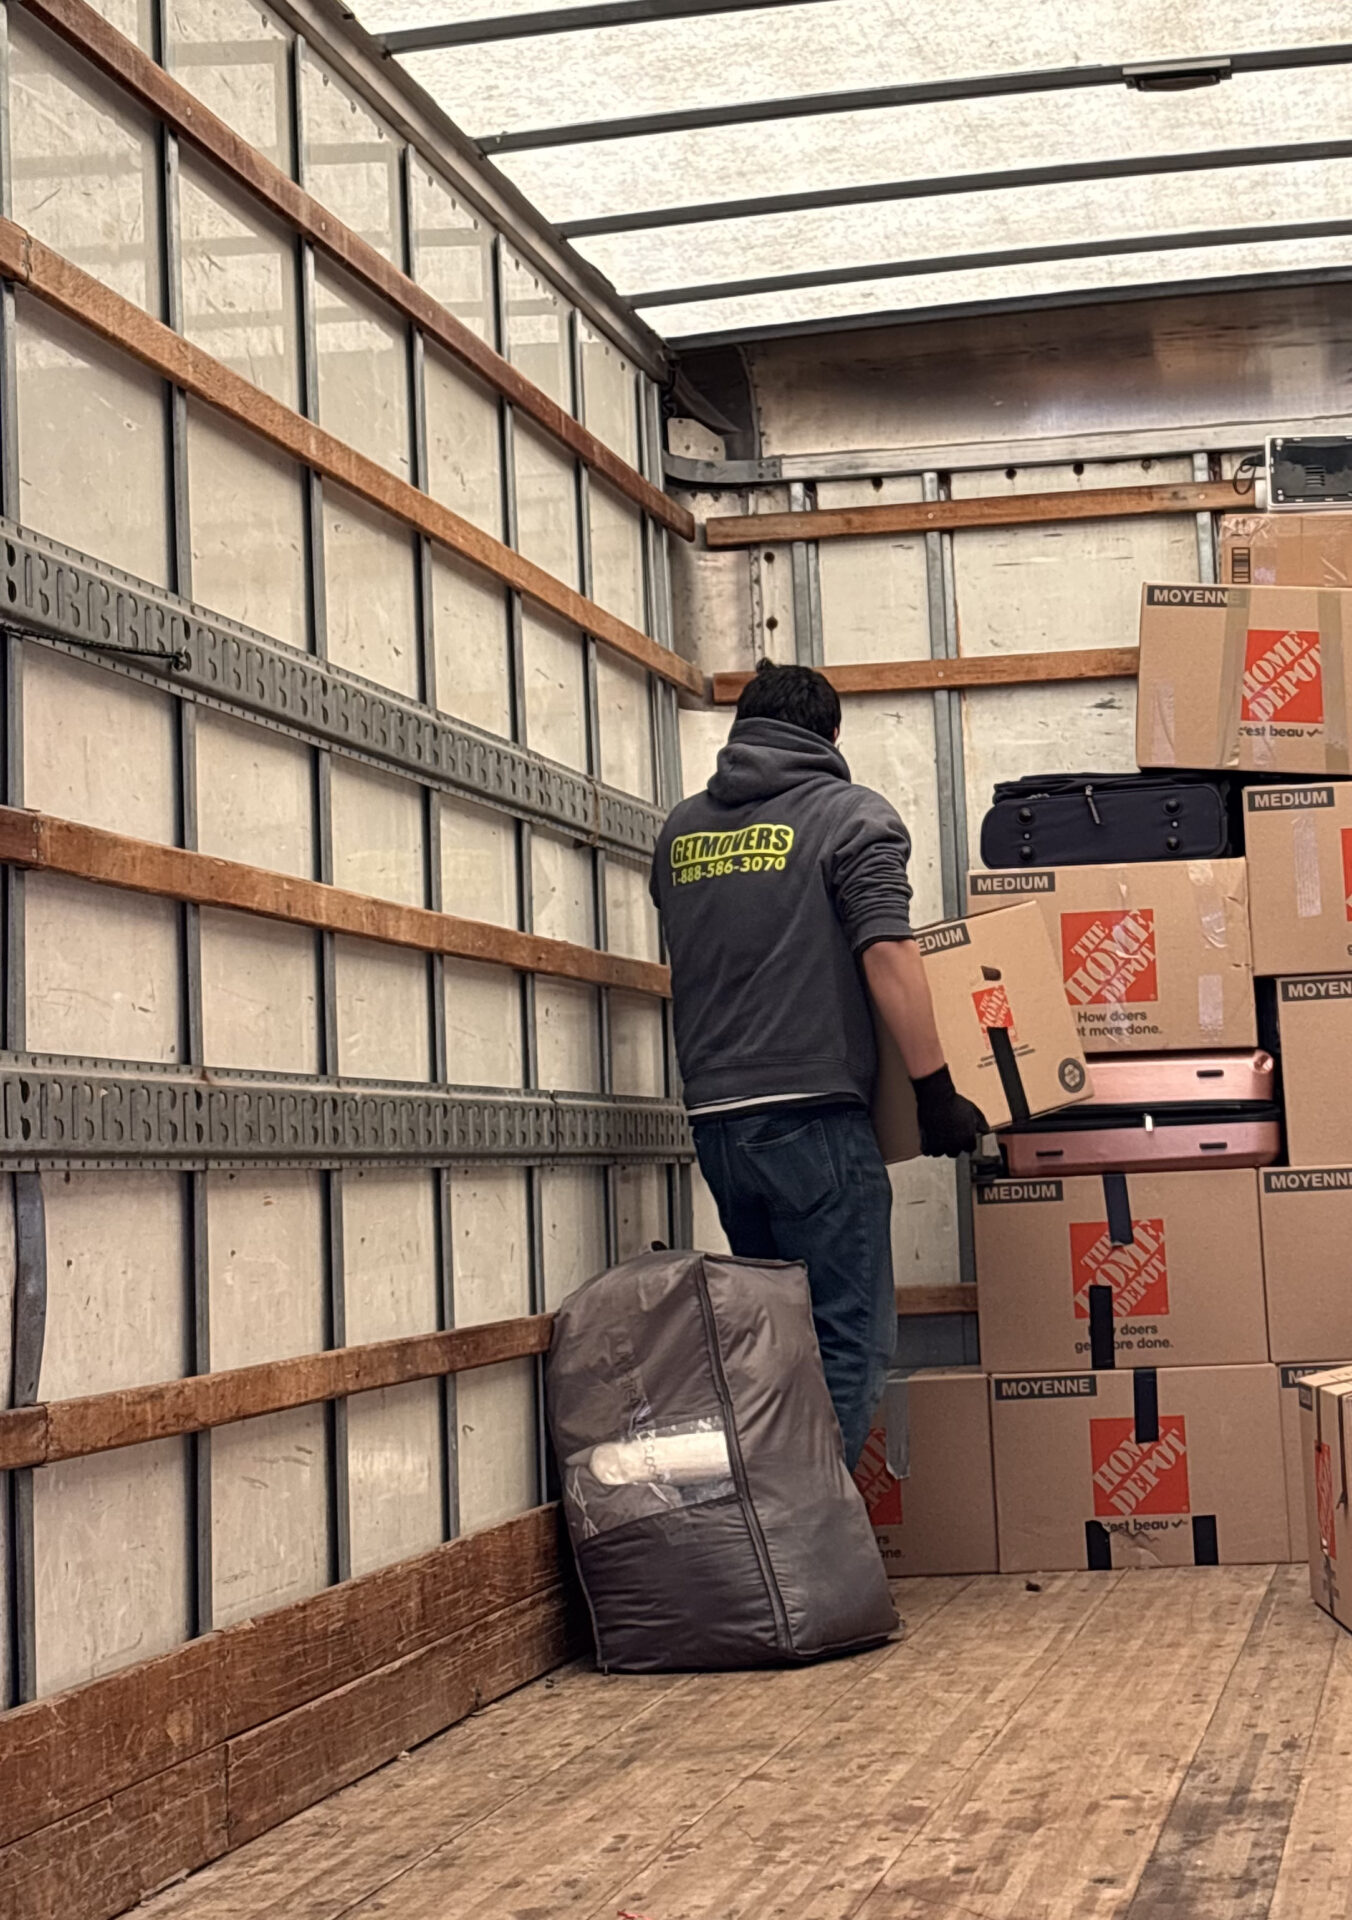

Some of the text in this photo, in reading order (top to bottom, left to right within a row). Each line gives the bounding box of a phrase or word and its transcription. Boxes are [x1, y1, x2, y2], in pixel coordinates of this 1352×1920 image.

[1242, 630, 1308, 700] HOME
[1269, 725, 1304, 737] beau
[1254, 790, 1328, 808] MEDIUM
[673, 827, 790, 865] GETMOVERS
[672, 856, 786, 887] 1-888-586-3070
[977, 875, 1049, 892] MEDIUM
[919, 927, 965, 951] EDIUM
[1070, 920, 1109, 959] THE
[1064, 908, 1155, 1005] HOME
[1100, 942, 1157, 1003] DEPOT
[1288, 981, 1352, 998] MOYEN
[1077, 1010, 1148, 1023] How doers
[1089, 1026, 1123, 1037] more
[1125, 1024, 1163, 1036] done.
[1271, 1172, 1352, 1189] MOYENN
[983, 1184, 1057, 1200] MEDIUM
[1112, 1253, 1167, 1316] DEPOT
[1120, 1324, 1158, 1336] doers
[1075, 1337, 1174, 1354] ge ore done.
[1002, 1378, 1090, 1396] MOYENNE
[1093, 1425, 1165, 1495] HOM
[1109, 1428, 1187, 1516] DEPOT
[1104, 1518, 1169, 1533] 'est beau
[880, 1549, 906, 1559] one.
